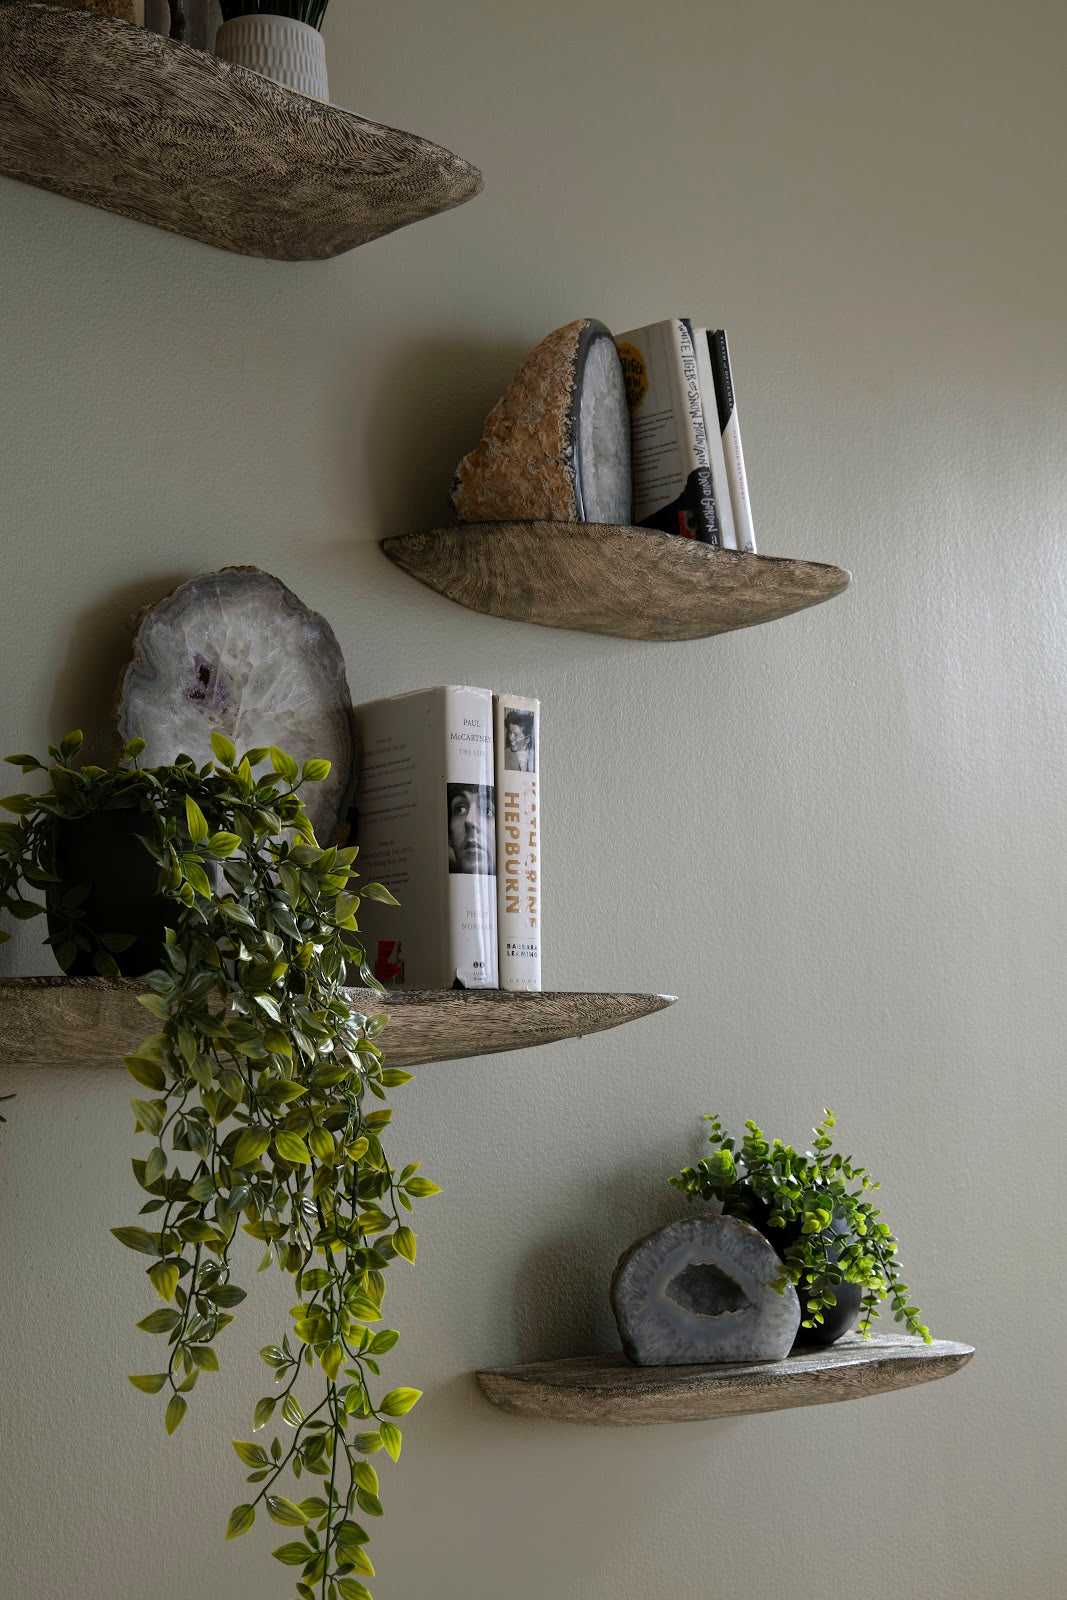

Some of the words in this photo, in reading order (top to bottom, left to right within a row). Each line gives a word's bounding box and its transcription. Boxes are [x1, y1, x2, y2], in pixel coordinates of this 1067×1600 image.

[678, 325, 691, 352] WHITE
[681, 355, 696, 381] TIGER
[688, 391, 702, 418] SNOW
[693, 422, 708, 466] MOUNTAIN
[698, 472, 712, 495] DAVID
[463, 719, 480, 728] PAUL
[504, 792, 520, 914] HEPBURN
